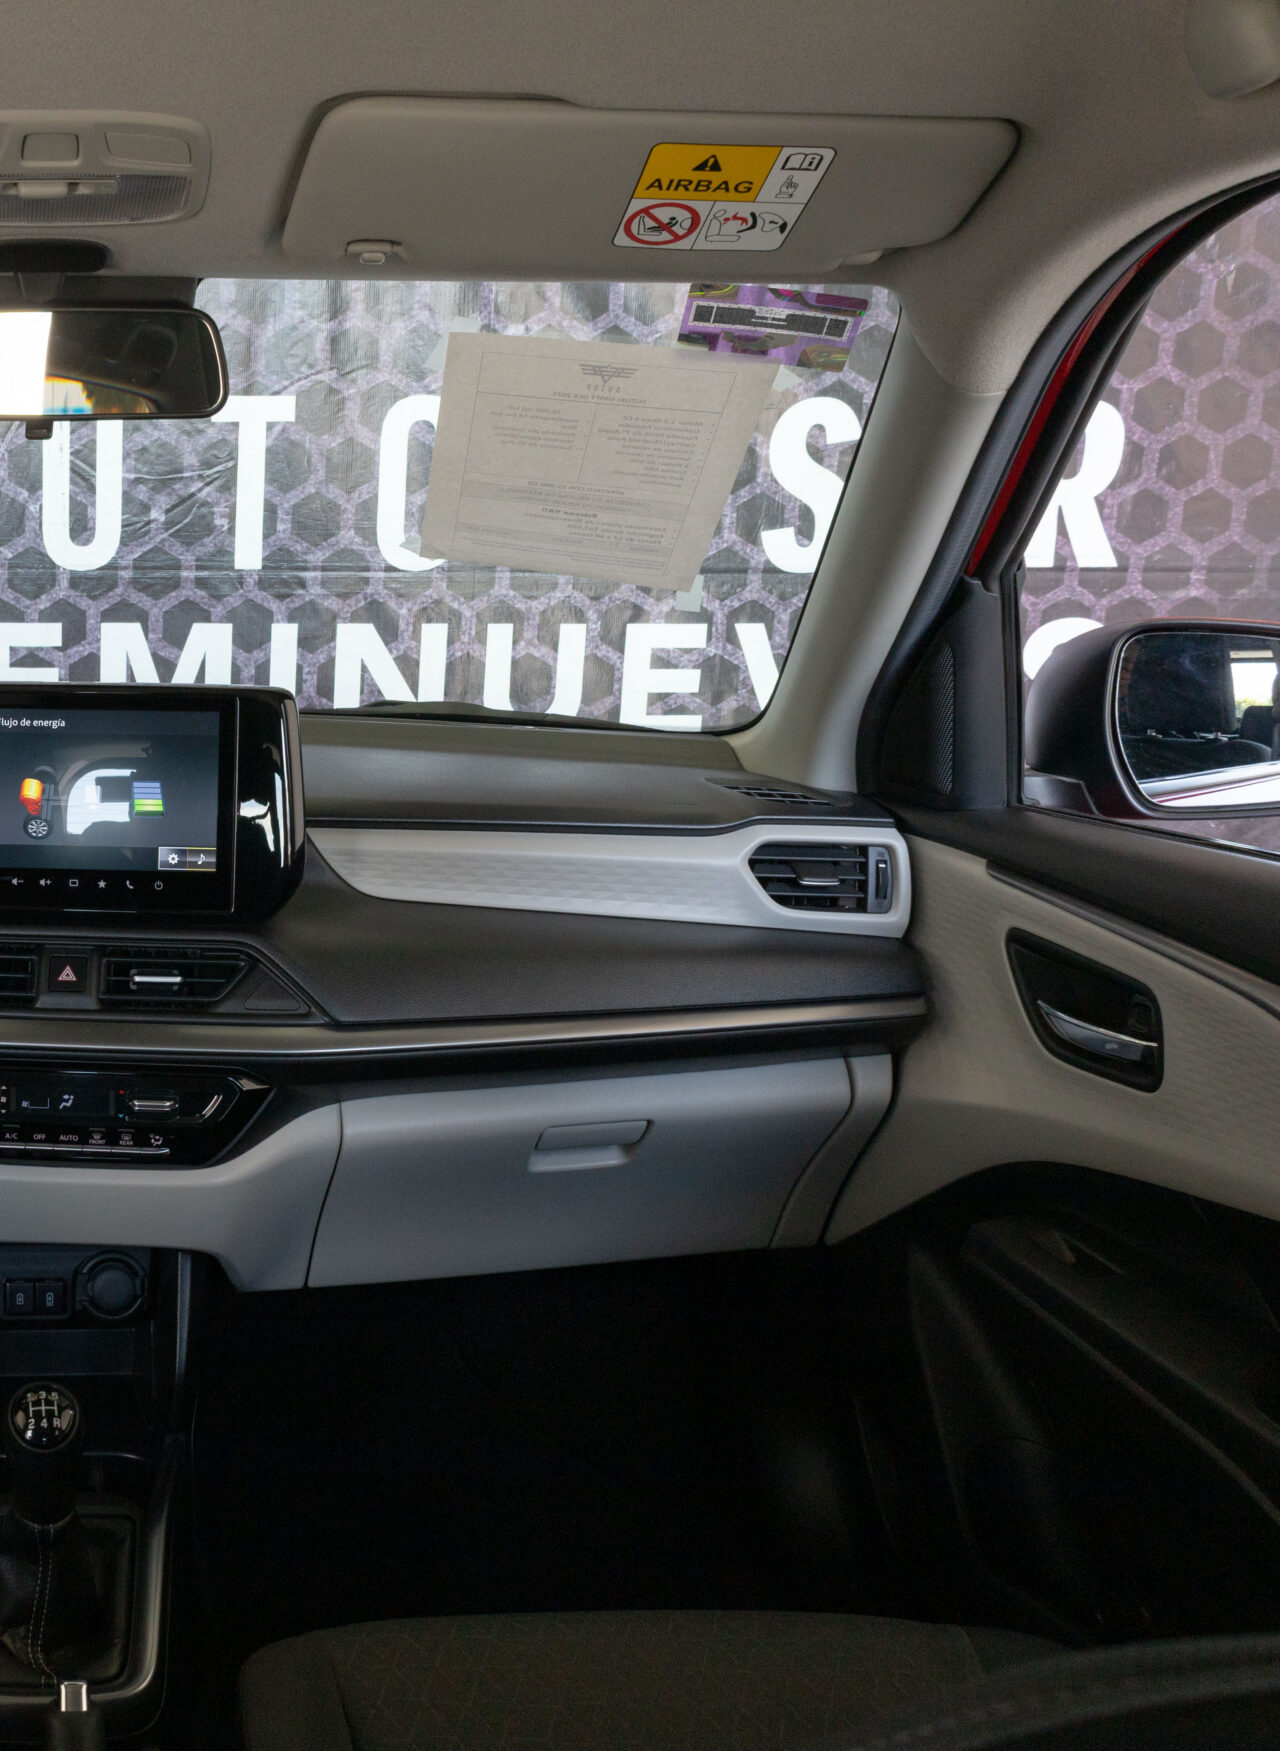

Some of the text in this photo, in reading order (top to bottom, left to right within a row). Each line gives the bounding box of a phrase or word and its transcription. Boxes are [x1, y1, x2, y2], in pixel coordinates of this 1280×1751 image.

[645, 178, 754, 194] AIRBAG
[20, 718, 31, 726] de
[32, 718, 66, 729] energía
[5, 1132, 18, 1140] A/C
[33, 1133, 46, 1141] OFF
[59, 1134, 79, 1142] AUTO
[28, 1417, 61, 1429] 2 4 R
